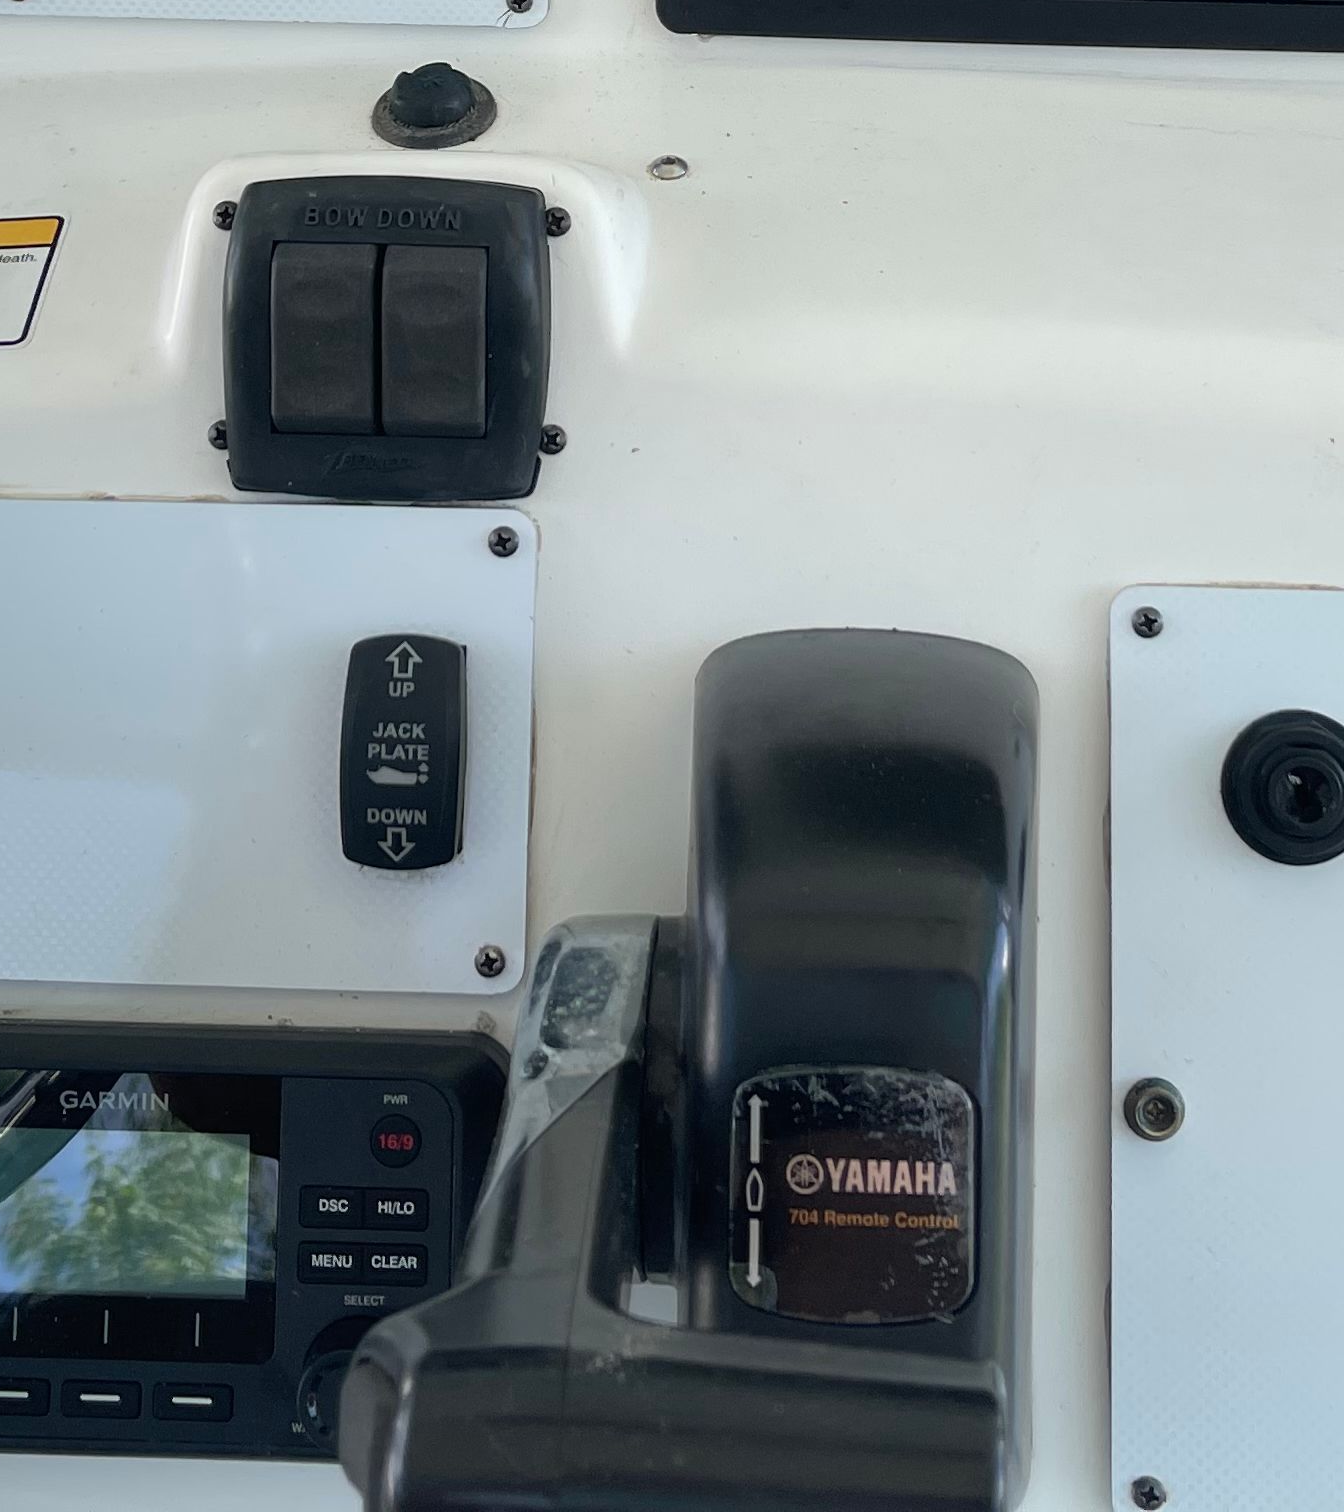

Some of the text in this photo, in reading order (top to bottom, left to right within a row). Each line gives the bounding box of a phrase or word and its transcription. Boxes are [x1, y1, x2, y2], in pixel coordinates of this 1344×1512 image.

[304, 206, 462, 230] BOW DOWN
[388, 682, 415, 697] UP
[373, 722, 425, 738] JACK
[367, 743, 429, 761] PLATE
[367, 807, 427, 825] DOWN
[59, 1090, 170, 1112] GARMIN
[382, 1094, 408, 1106] PWR
[378, 1133, 414, 1152] 16/9
[825, 1157, 957, 1196] YAMAHA
[318, 1197, 349, 1214] DSC
[377, 1199, 415, 1216] HI/LO
[788, 1208, 959, 1229] 704 Remote Control
[310, 1252, 353, 1270] MENU
[370, 1254, 418, 1270] CLEAR
[344, 1295, 385, 1306] SELECT
